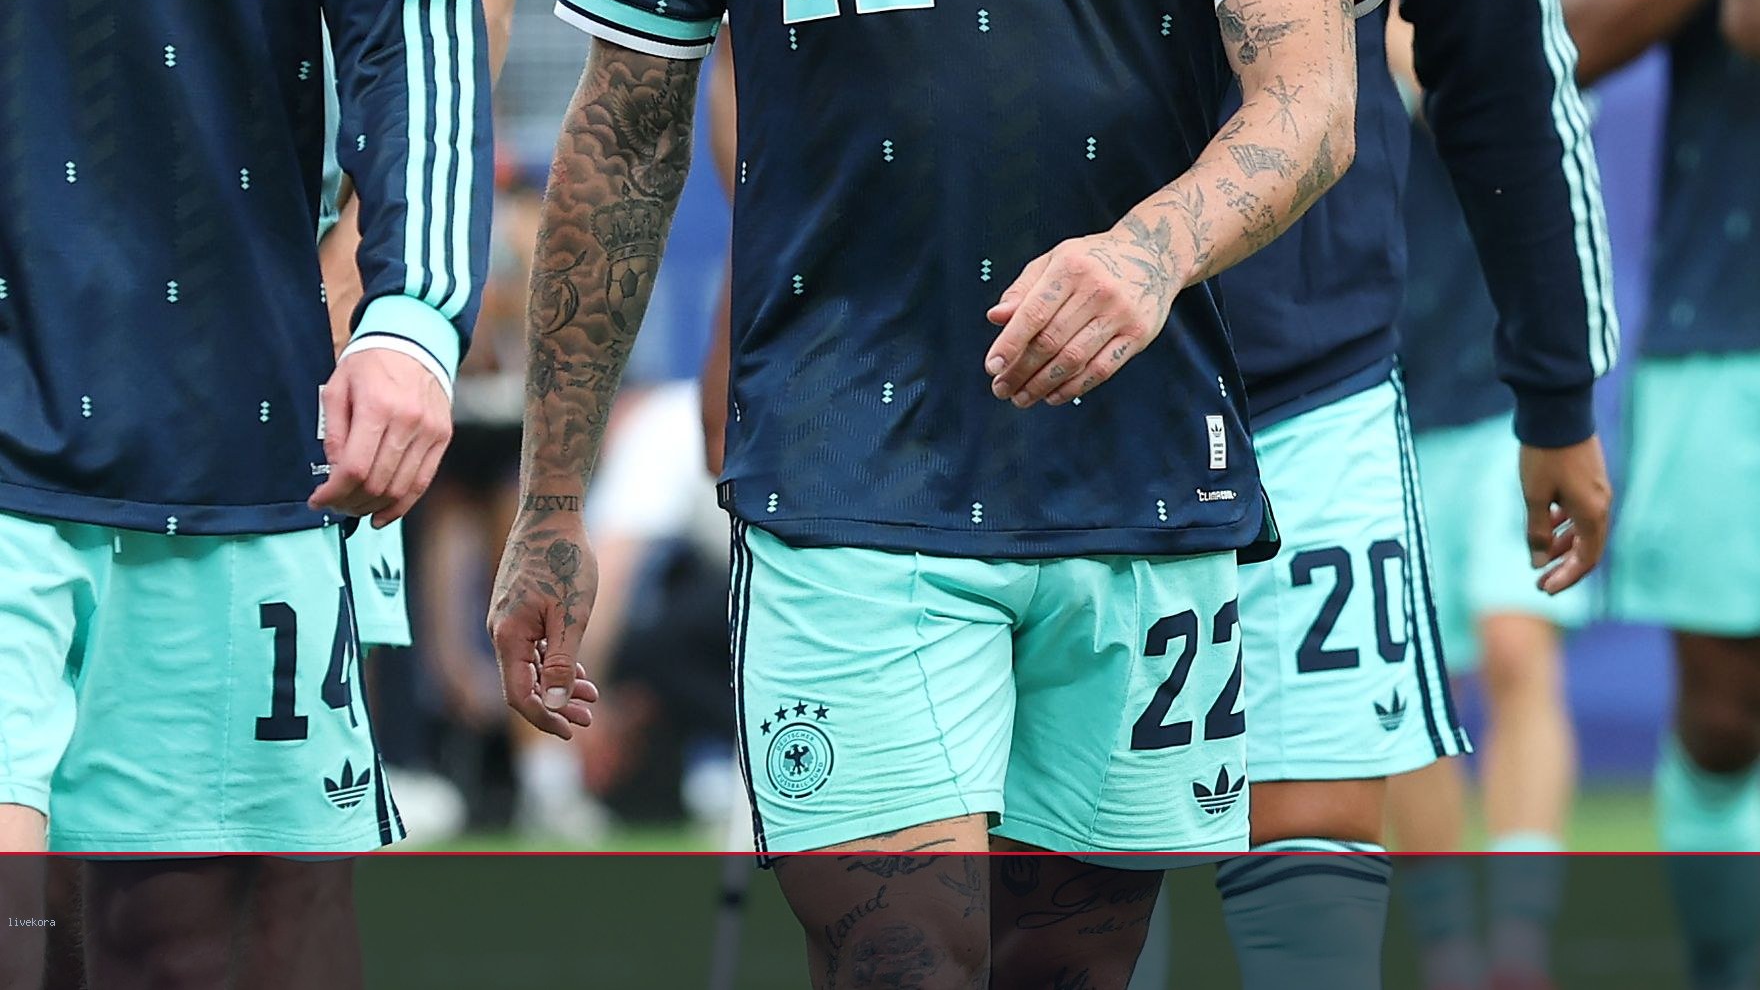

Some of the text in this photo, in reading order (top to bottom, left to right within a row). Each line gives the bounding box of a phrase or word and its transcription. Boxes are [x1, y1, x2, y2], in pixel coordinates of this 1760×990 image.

[255, 585, 359, 741] 14
[1130, 593, 1246, 750] 22
[1289, 539, 1410, 674] 20
